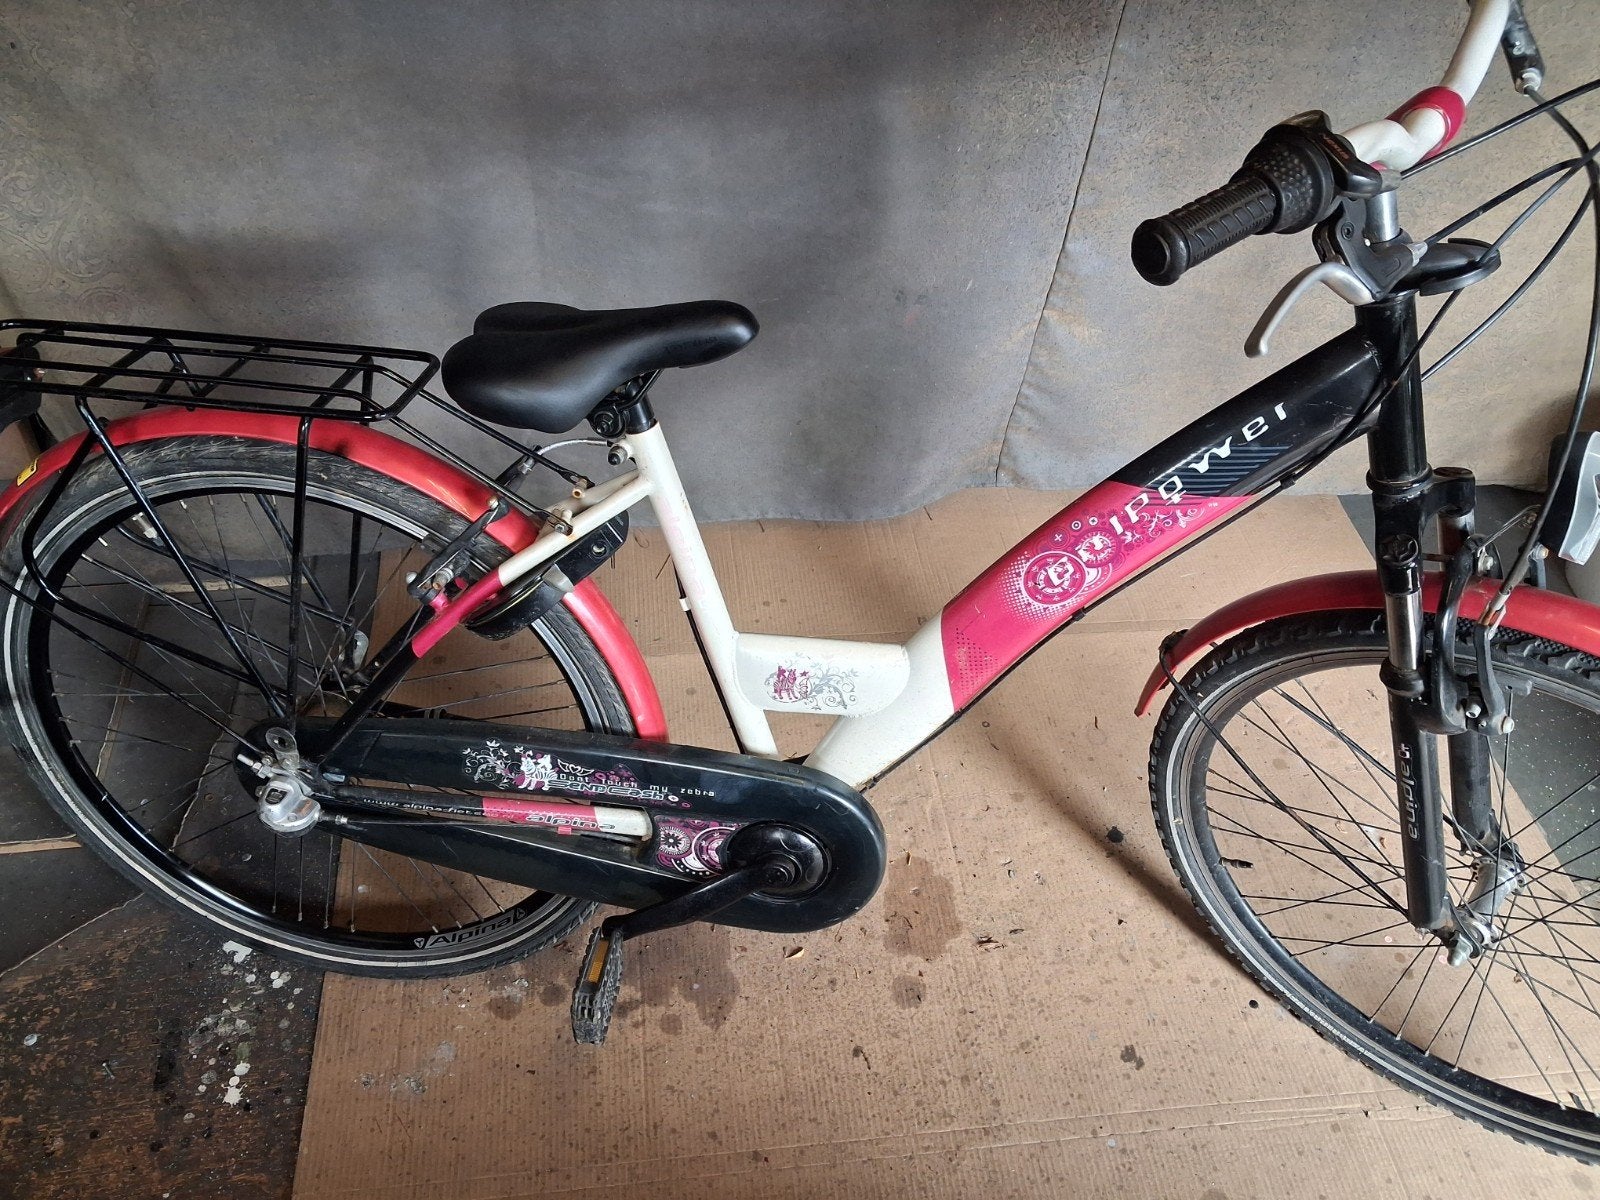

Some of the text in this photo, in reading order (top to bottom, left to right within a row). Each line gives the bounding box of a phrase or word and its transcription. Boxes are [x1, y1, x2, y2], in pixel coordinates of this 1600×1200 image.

[680, 788, 715, 797] zebra
[1400, 760, 1418, 840] alpina
[526, 813, 616, 830] alpina
[429, 916, 512, 947] Alpina
